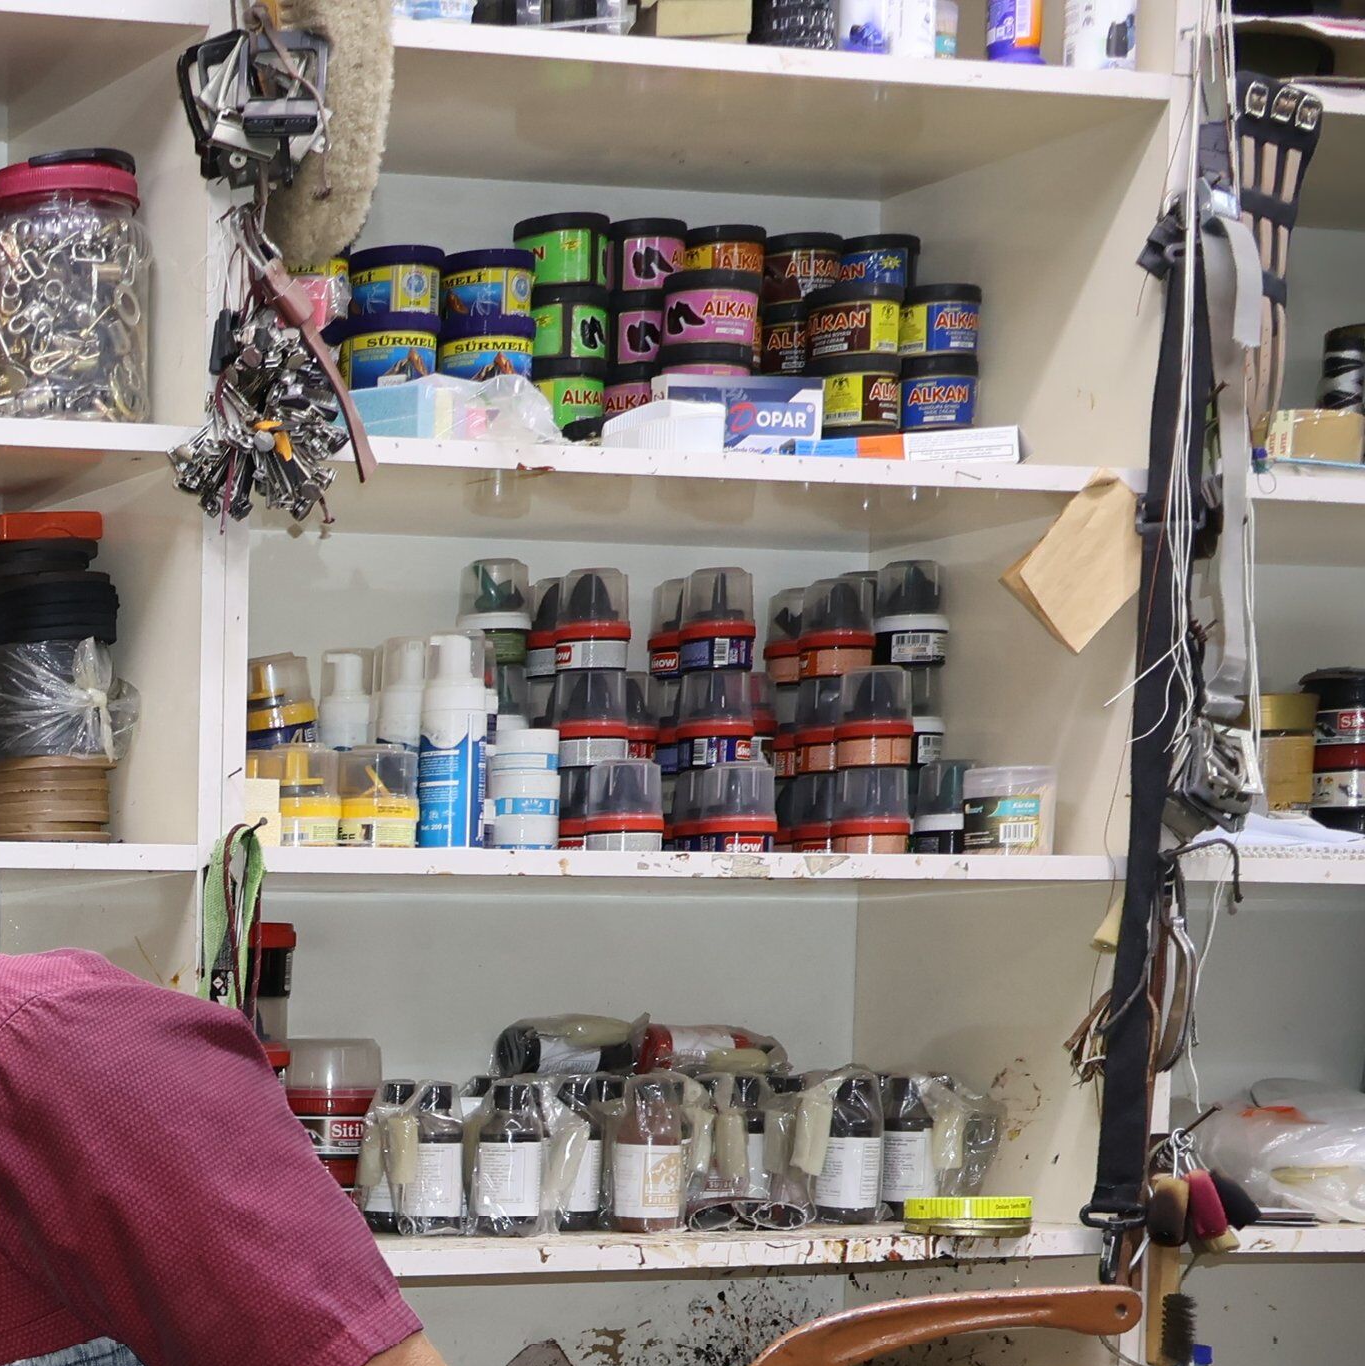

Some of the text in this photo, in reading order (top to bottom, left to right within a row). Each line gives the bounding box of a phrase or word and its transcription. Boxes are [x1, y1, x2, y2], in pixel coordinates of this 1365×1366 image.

[785, 259, 840, 279] ALKA
[702, 299, 755, 319] ALKAN
[934, 310, 981, 331] ALKA
[455, 339, 531, 354] SÜRMELİ
[768, 328, 806, 351] ALK
[869, 382, 899, 401] ALK
[907, 384, 970, 408] ALKAN
[728, 402, 809, 433] DOPAR
